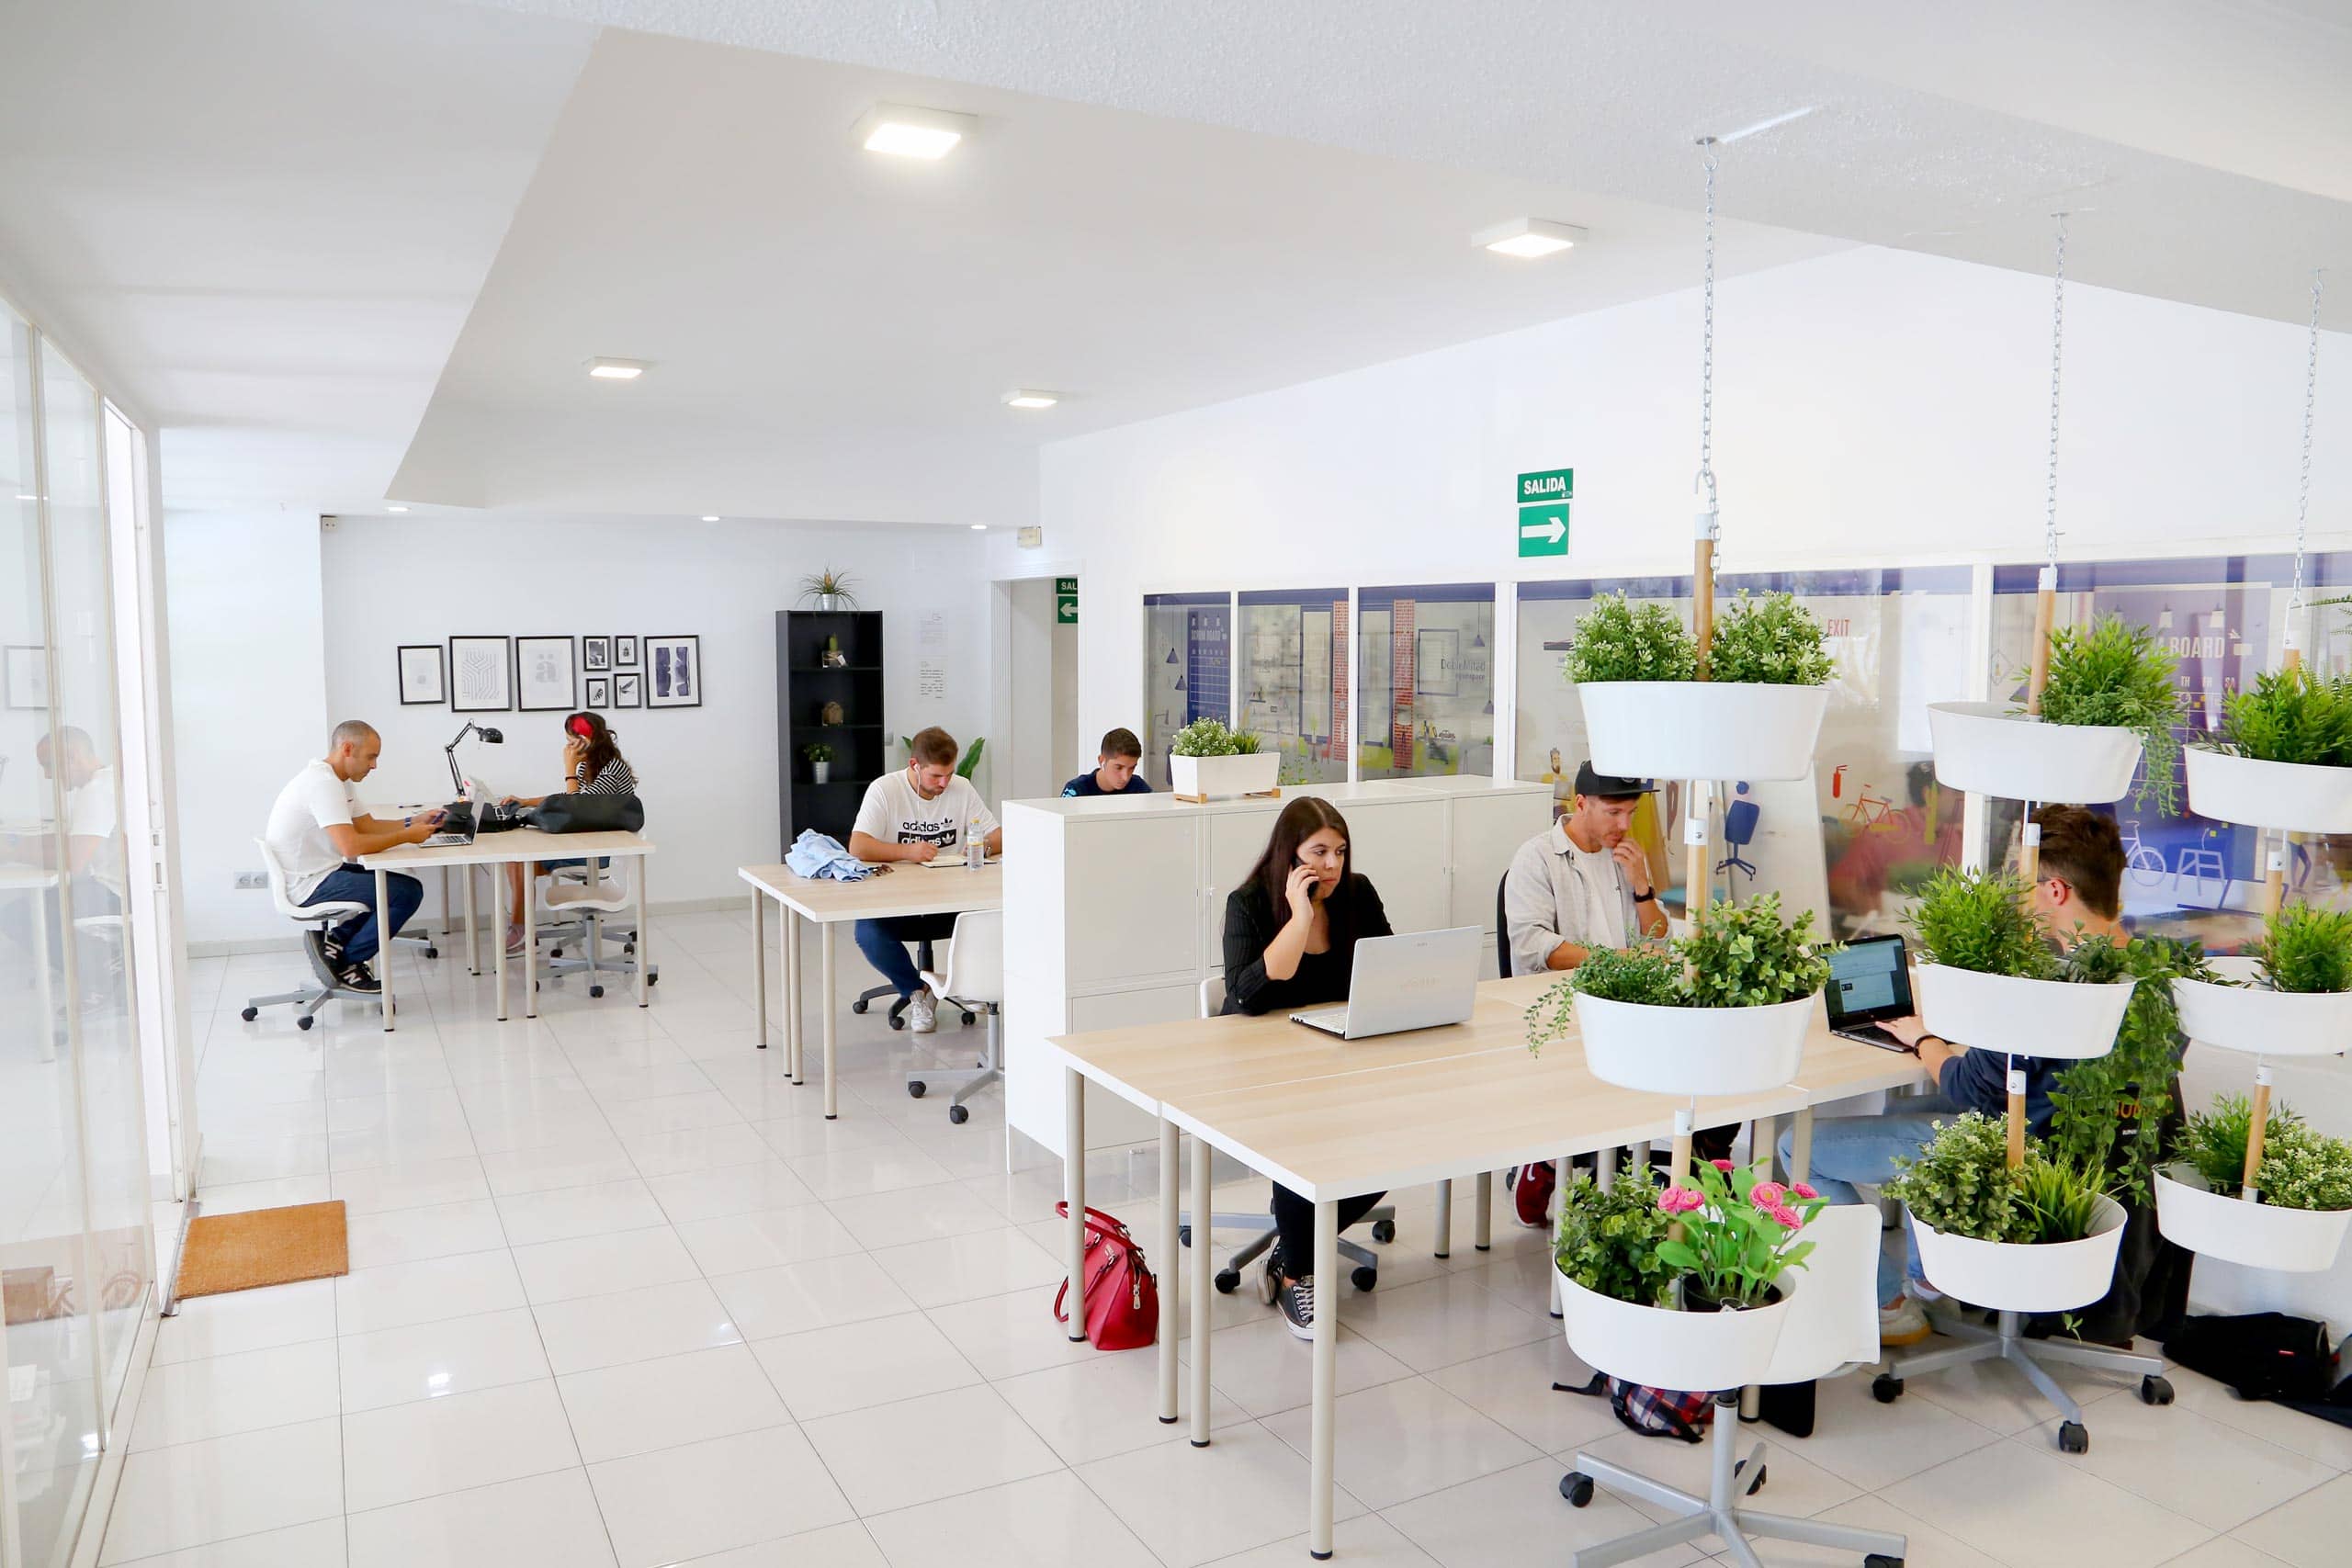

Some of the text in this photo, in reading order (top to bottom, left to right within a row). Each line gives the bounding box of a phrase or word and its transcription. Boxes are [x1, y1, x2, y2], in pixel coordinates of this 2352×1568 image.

[1523, 476, 1566, 495] SALIDA
[1060, 581, 1078, 591] SAL
[1827, 617, 1850, 637] EXIT
[2168, 637, 2225, 659] BOARD
